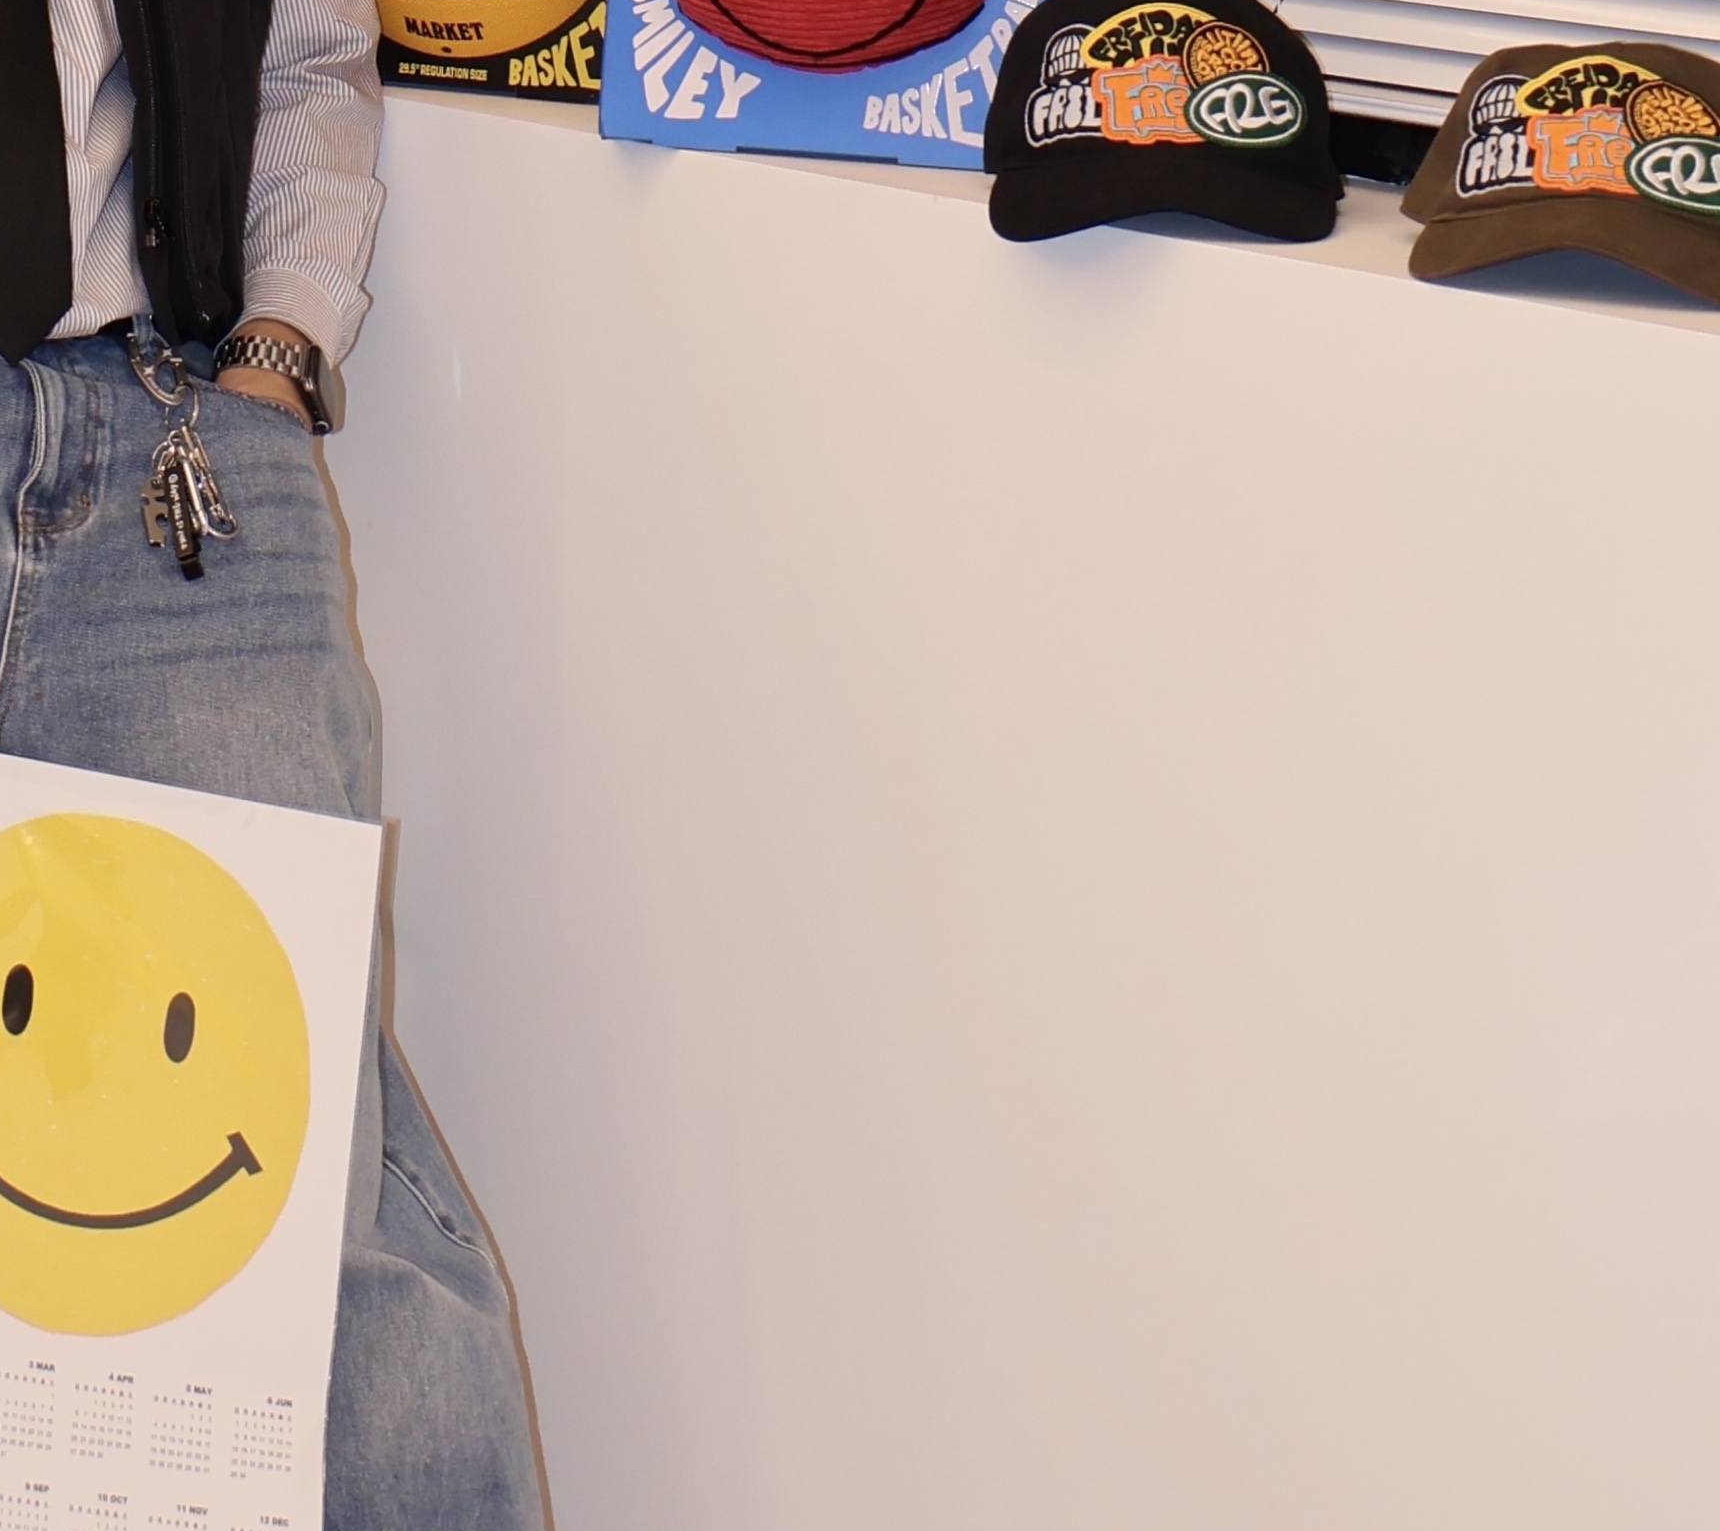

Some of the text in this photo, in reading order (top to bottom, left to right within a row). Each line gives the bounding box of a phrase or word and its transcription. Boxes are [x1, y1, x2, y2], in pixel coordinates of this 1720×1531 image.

[404, 16, 484, 41] MARKET
[420, 63, 469, 80] REGULATION
[469, 68, 488, 81] SIZE
[36, 1362, 55, 1371] MAR
[116, 1374, 135, 1384] APR
[193, 1385, 213, 1395] MAY
[275, 1398, 293, 1407] JUN
[33, 1483, 50, 1493] SEP
[110, 1494, 128, 1504] OCT
[189, 1505, 208, 1516] NOV
[272, 1517, 289, 1527] DEC
